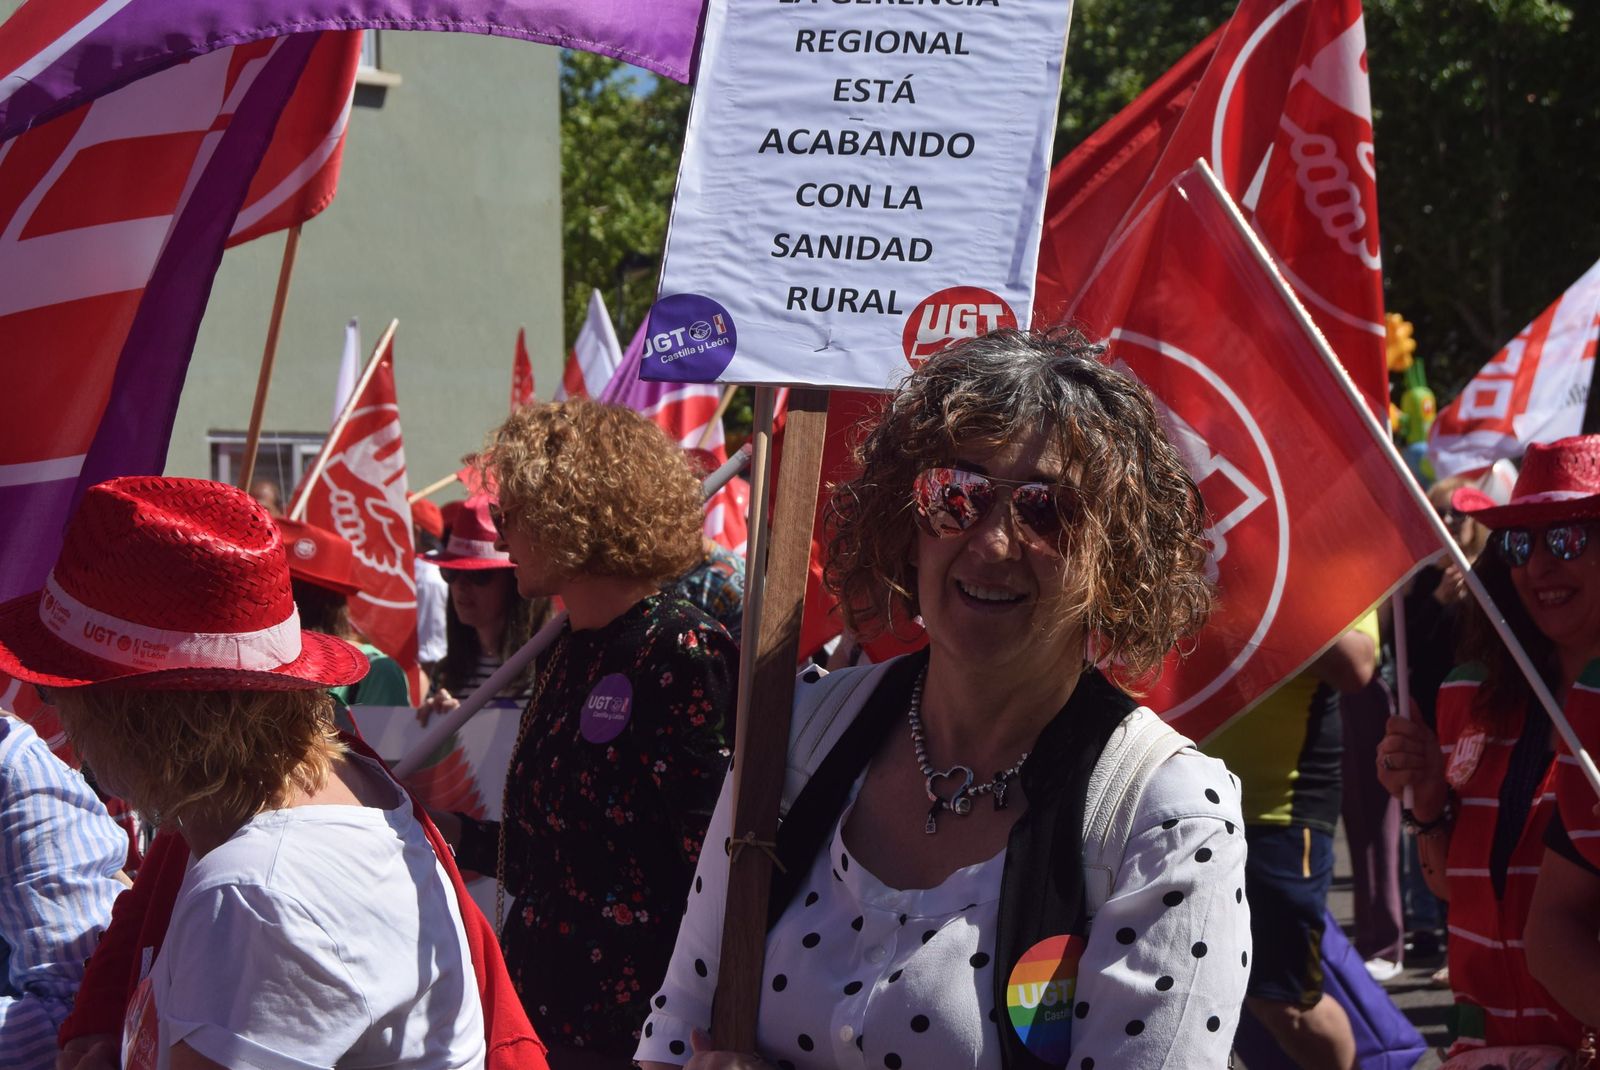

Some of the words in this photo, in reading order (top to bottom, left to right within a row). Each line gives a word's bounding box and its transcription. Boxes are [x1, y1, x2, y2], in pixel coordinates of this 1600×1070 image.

[795, 29, 970, 55] REGIONAL
[833, 73, 916, 104] ESTÁ
[758, 128, 975, 159] ACABANDO
[796, 182, 871, 209] CON
[883, 184, 923, 210] LA
[771, 232, 933, 262] SANIDAD
[786, 286, 903, 315] RURAL
[916, 303, 1003, 345] UGT
[660, 347, 696, 364] Castilla
[697, 344, 704, 353] y
[705, 337, 730, 349] León
[83, 621, 118, 646] UGT
[588, 695, 613, 710] UGT
[1018, 980, 1072, 1009] UGT
